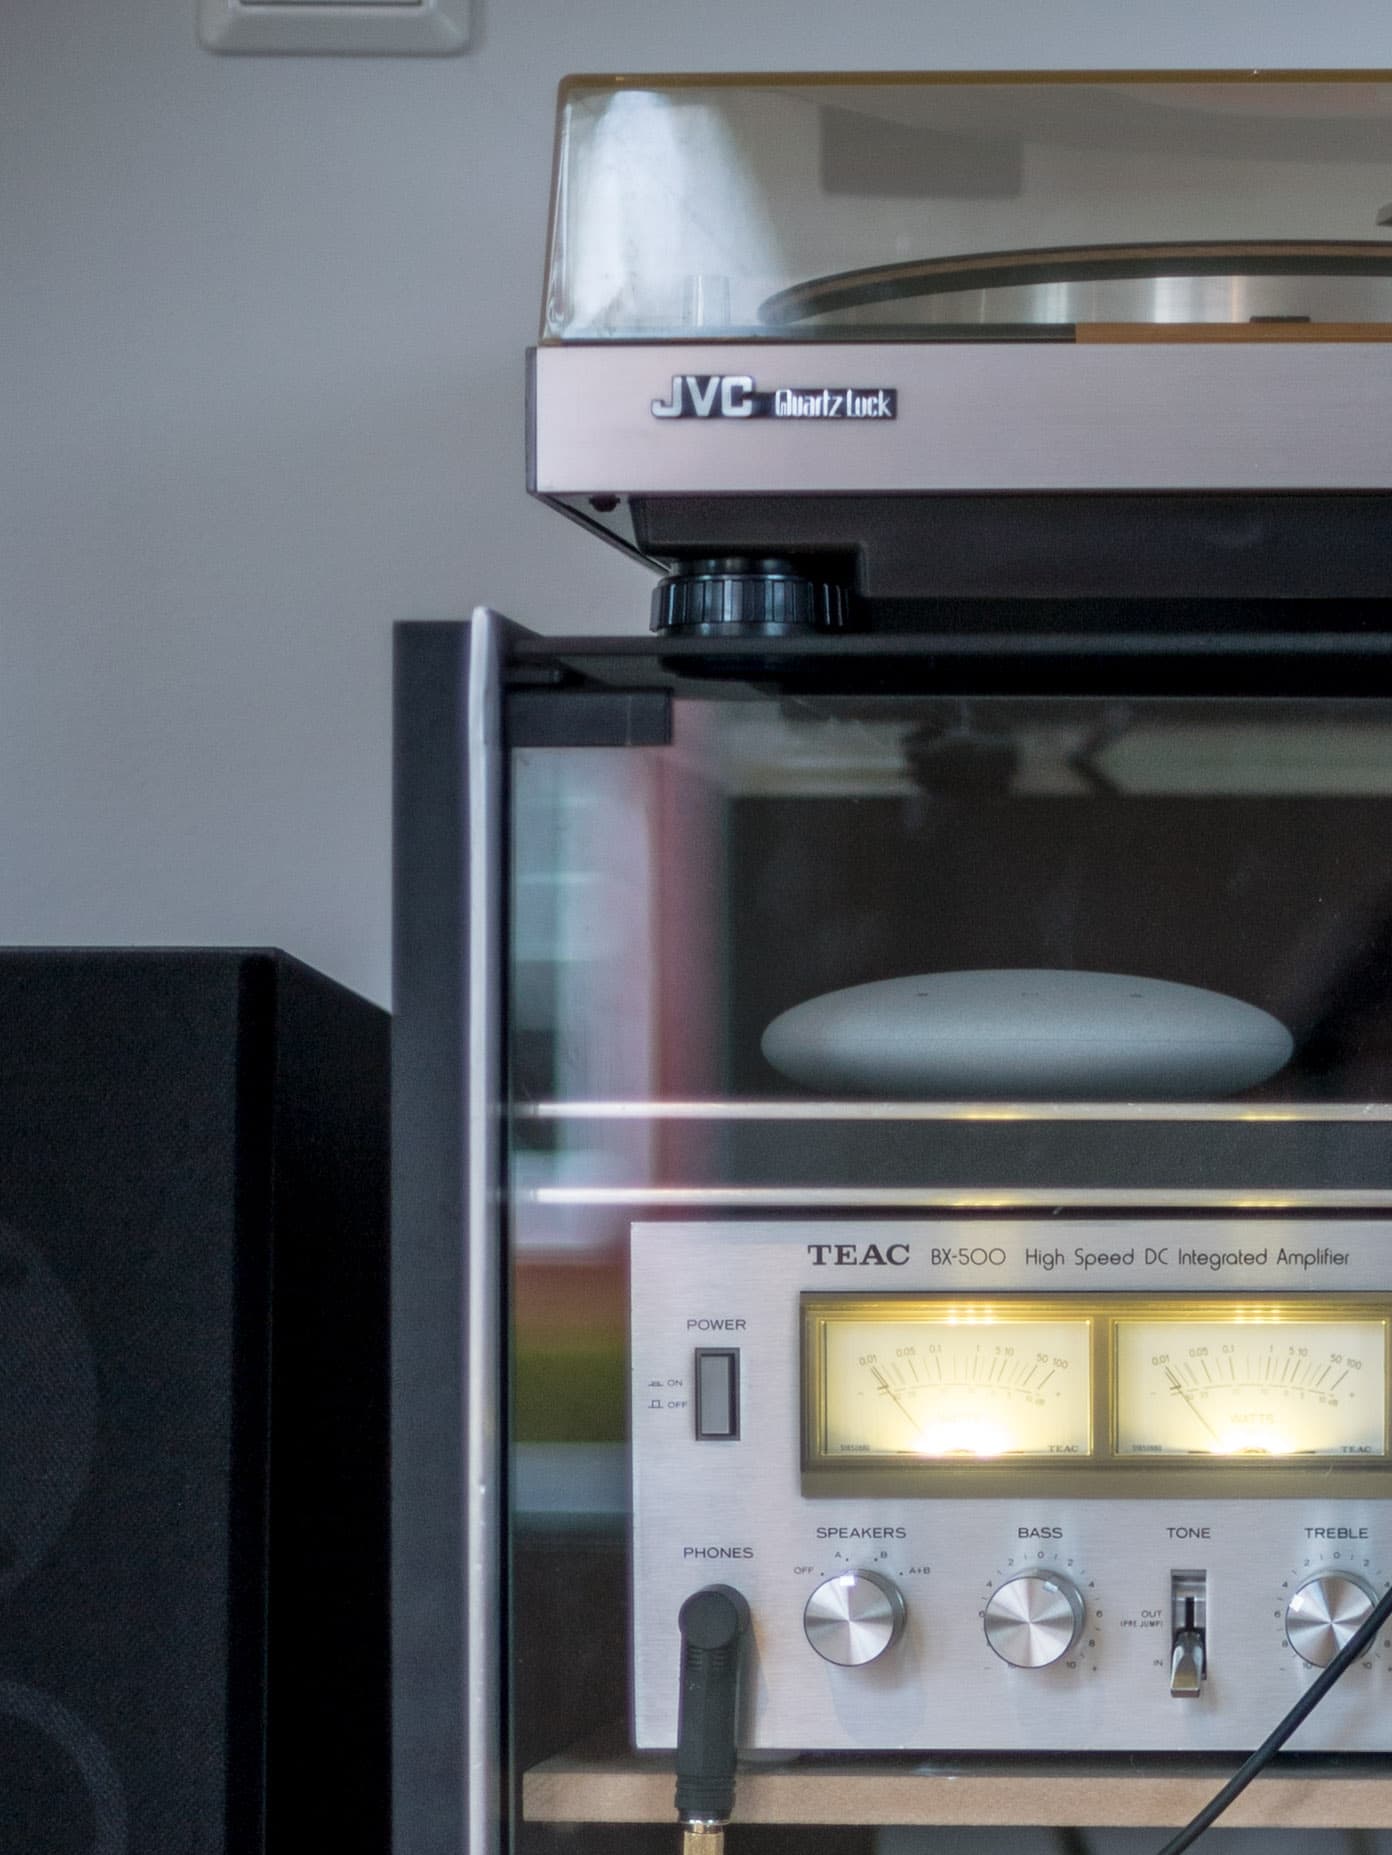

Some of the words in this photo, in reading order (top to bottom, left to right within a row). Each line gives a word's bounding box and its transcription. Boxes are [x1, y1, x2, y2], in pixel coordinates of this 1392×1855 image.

[651, 376, 752, 416] JVC
[775, 389, 842, 417] Quartz
[847, 389, 891, 417] Lock
[807, 1244, 910, 1265] TEAC
[931, 1248, 1006, 1265] BX-500
[1025, 1248, 1064, 1271] High
[1075, 1248, 1134, 1271] Speed
[1145, 1248, 1169, 1265] DC
[1178, 1248, 1267, 1271] Integrated
[1276, 1248, 1350, 1271] Amplifier
[687, 1319, 746, 1331] POWER
[929, 1344, 942, 1354] 0.1
[1005, 1347, 1014, 1357] 10
[1222, 1344, 1235, 1354] 0.1
[1298, 1347, 1308, 1358] 10
[859, 1354, 878, 1366] 0.01
[1036, 1353, 1049, 1364] 50
[1052, 1357, 1069, 1369] 100
[1152, 1354, 1170, 1366] 0.01
[1330, 1353, 1343, 1365] 50
[1347, 1358, 1362, 1370] 100
[667, 1379, 683, 1387] ON
[667, 1401, 688, 1409] OFF
[1048, 1445, 1080, 1453] TEAC
[1341, 1445, 1372, 1453] TEAC
[816, 1527, 906, 1539] SPEAKERS
[1018, 1527, 1063, 1539] BASS
[1166, 1527, 1211, 1539] TONE
[1304, 1527, 1368, 1539] TREBLE
[683, 1547, 754, 1559] PHONES
[1037, 1551, 1044, 1559] 0
[1333, 1551, 1340, 1559] 0
[793, 1567, 814, 1575] OFF
[1141, 1609, 1162, 1617] OUT
